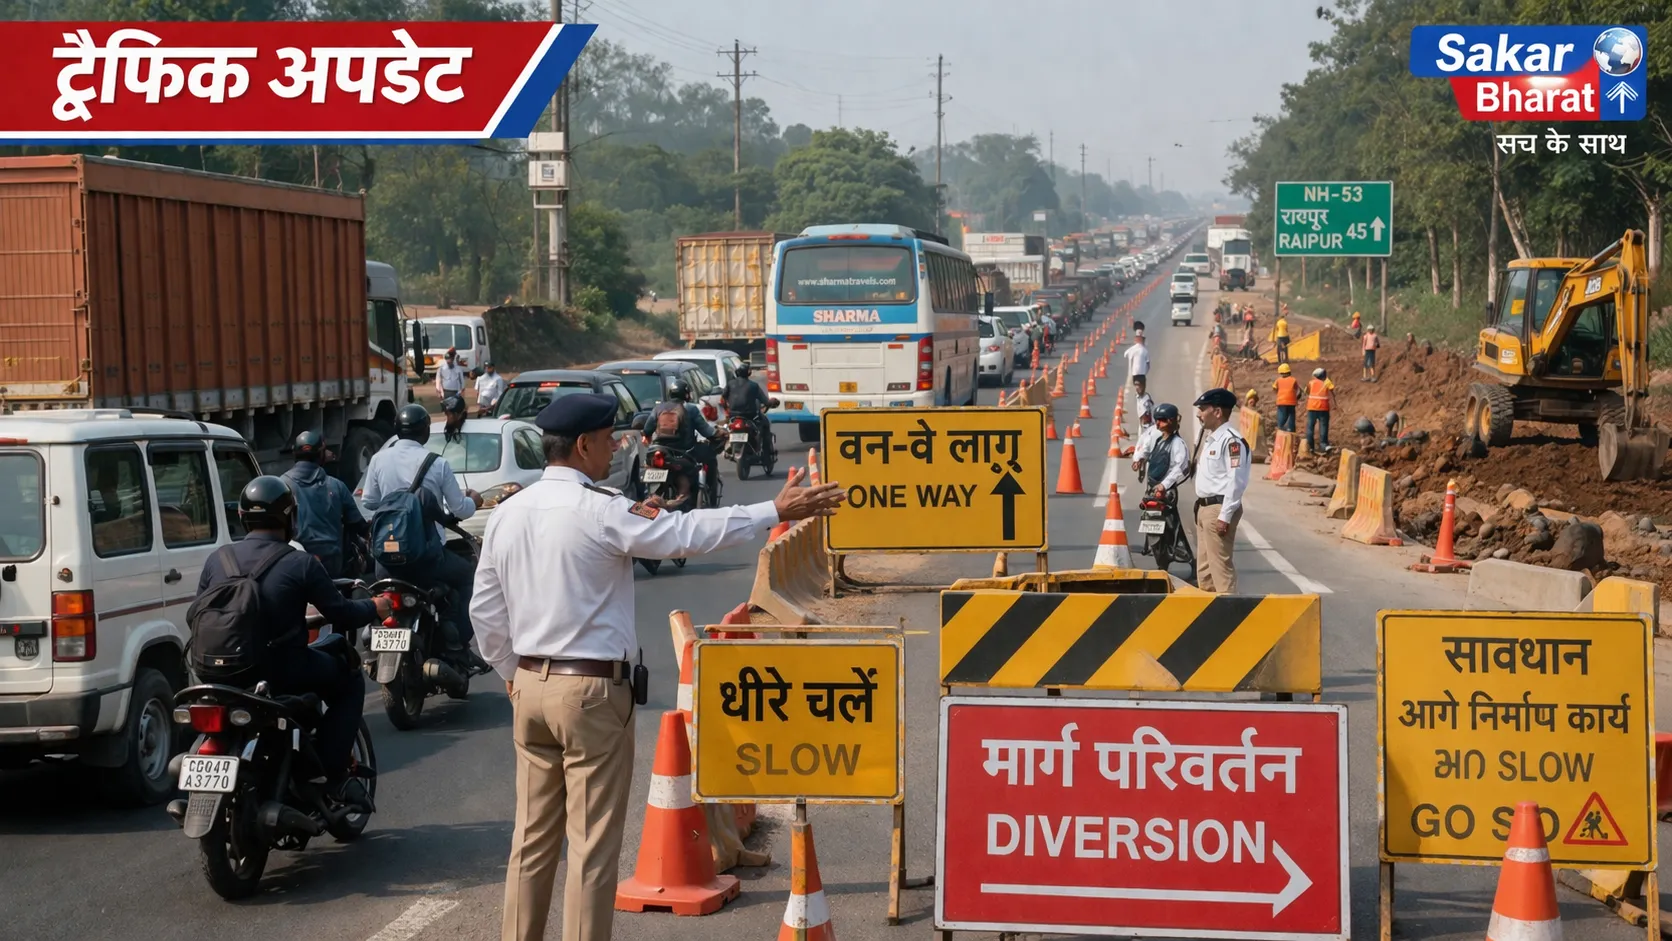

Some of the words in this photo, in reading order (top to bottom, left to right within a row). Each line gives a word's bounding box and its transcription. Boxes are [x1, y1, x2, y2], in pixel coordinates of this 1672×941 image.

[1304, 186, 1363, 202] NH-53
[1279, 233, 1343, 249] RAIPUR
[1346, 223, 1367, 240] 45
[813, 309, 881, 323] SHARMA
[836, 419, 937, 464] वन-वे
[847, 484, 907, 508] ONE
[916, 484, 978, 508] WAY
[1441, 636, 1592, 676] सावधान
[720, 666, 793, 722] धीरे
[803, 666, 878, 724] चलें
[1398, 689, 1460, 730] आगे
[1567, 692, 1632, 734] कार्य
[736, 743, 862, 776] SLOW
[981, 722, 1081, 788] मार्ग
[1093, 725, 1303, 794] परिवर्तन
[1498, 749, 1595, 783] SLOW
[184, 774, 229, 789] A3770
[986, 813, 1266, 864] DIVERSION
[1410, 803, 1476, 840] GO
